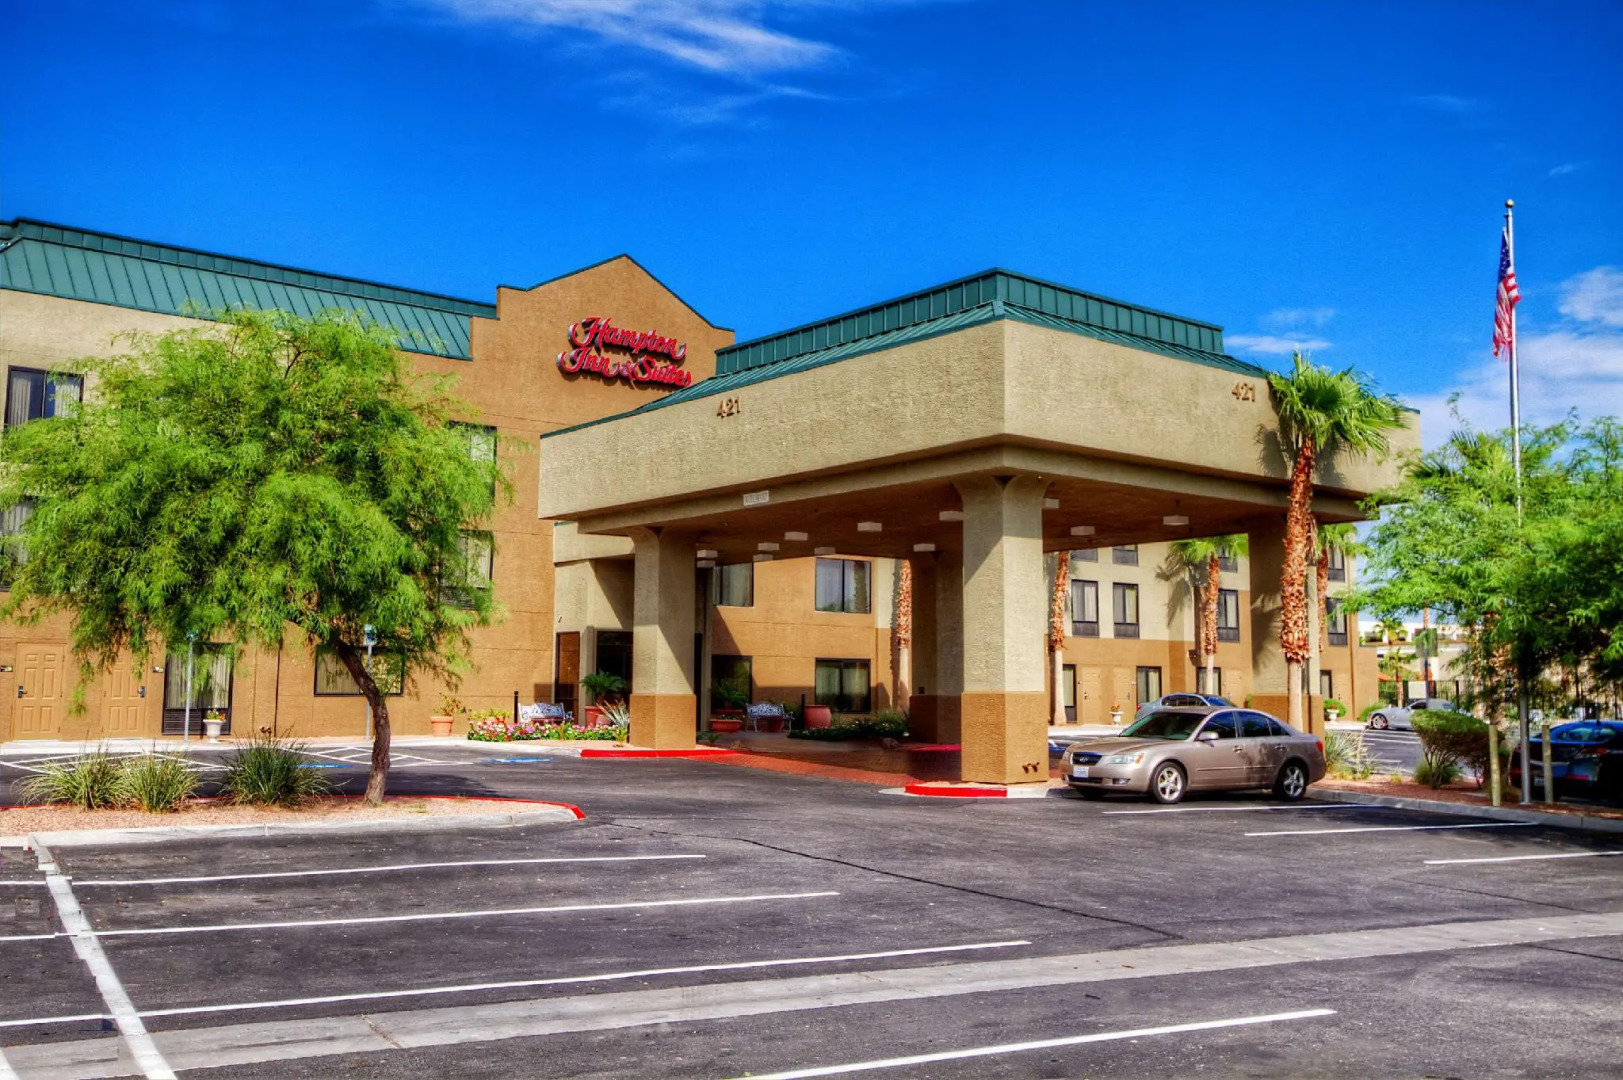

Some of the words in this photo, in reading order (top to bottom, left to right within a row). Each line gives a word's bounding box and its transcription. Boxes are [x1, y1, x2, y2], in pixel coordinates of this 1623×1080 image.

[568, 317, 687, 357] Hampton
[557, 347, 620, 377] Inn
[620, 361, 635, 382] &
[633, 356, 692, 387] Suites
[717, 395, 740, 418] 421
[1231, 382, 1256, 403] 421
